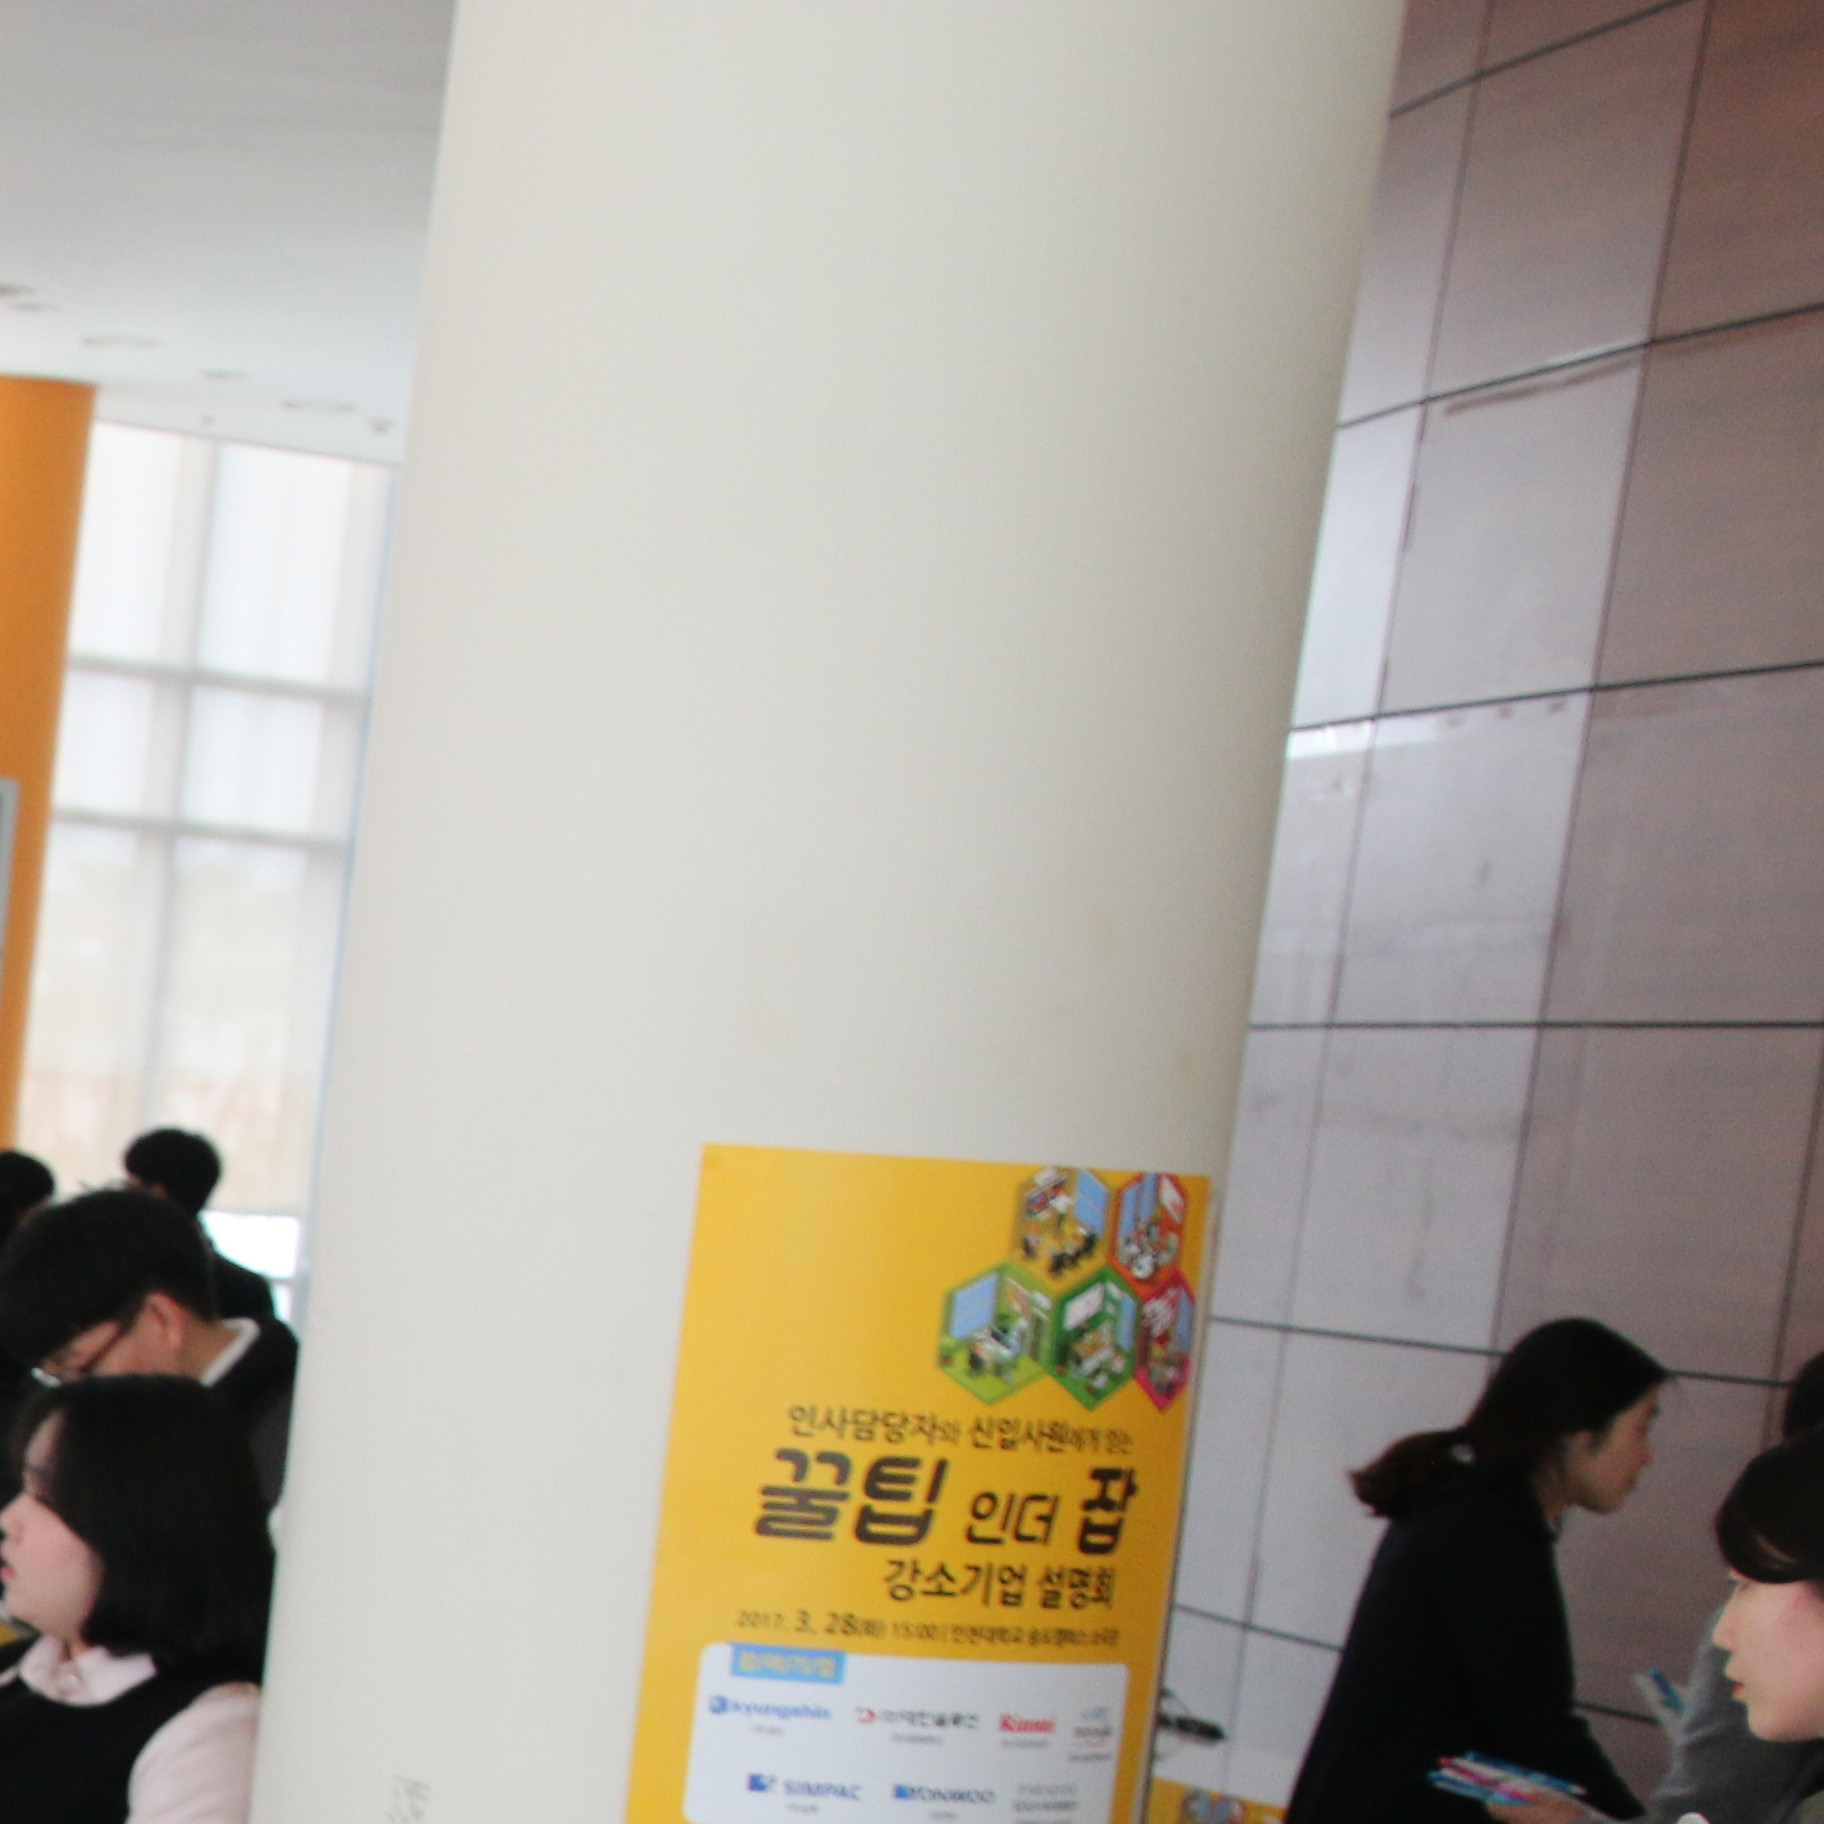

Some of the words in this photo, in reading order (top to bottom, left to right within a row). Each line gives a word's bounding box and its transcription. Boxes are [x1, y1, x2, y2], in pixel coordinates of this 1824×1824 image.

[755, 1447, 949, 1547] 꿀팁
[965, 1490, 1059, 1546] 인더
[1076, 1466, 1140, 1556] 잡
[884, 1558, 1027, 1608] 강소기업
[1038, 1564, 1117, 1610] 설명회
